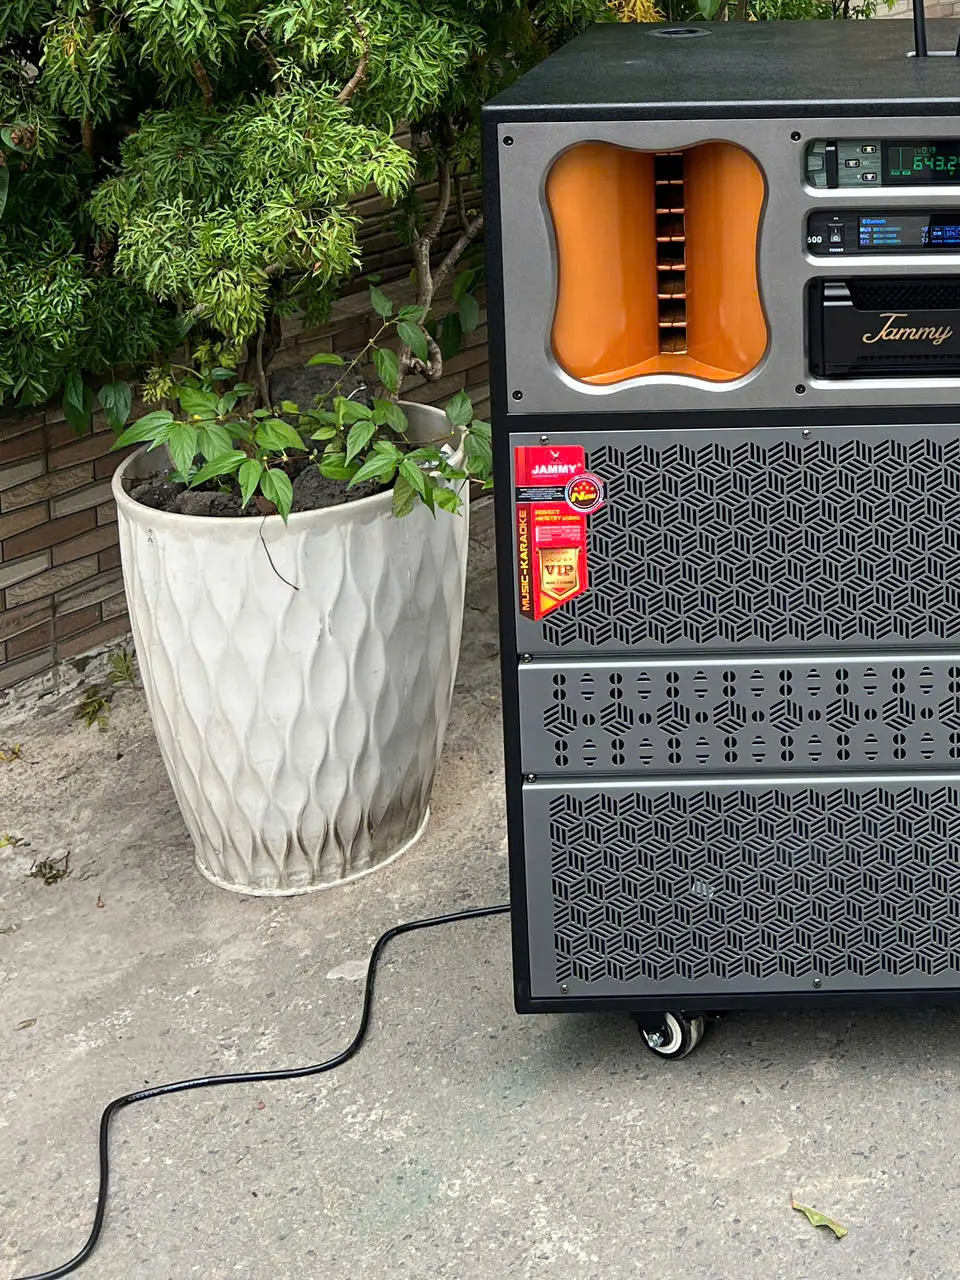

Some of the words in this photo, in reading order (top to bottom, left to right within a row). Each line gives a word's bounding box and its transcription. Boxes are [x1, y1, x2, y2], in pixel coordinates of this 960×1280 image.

[862, 313, 953, 345] Jammy
[531, 464, 577, 474] JAMMY
[519, 509, 531, 611] MUSIC-KARAOKE
[544, 565, 574, 576] VIP
